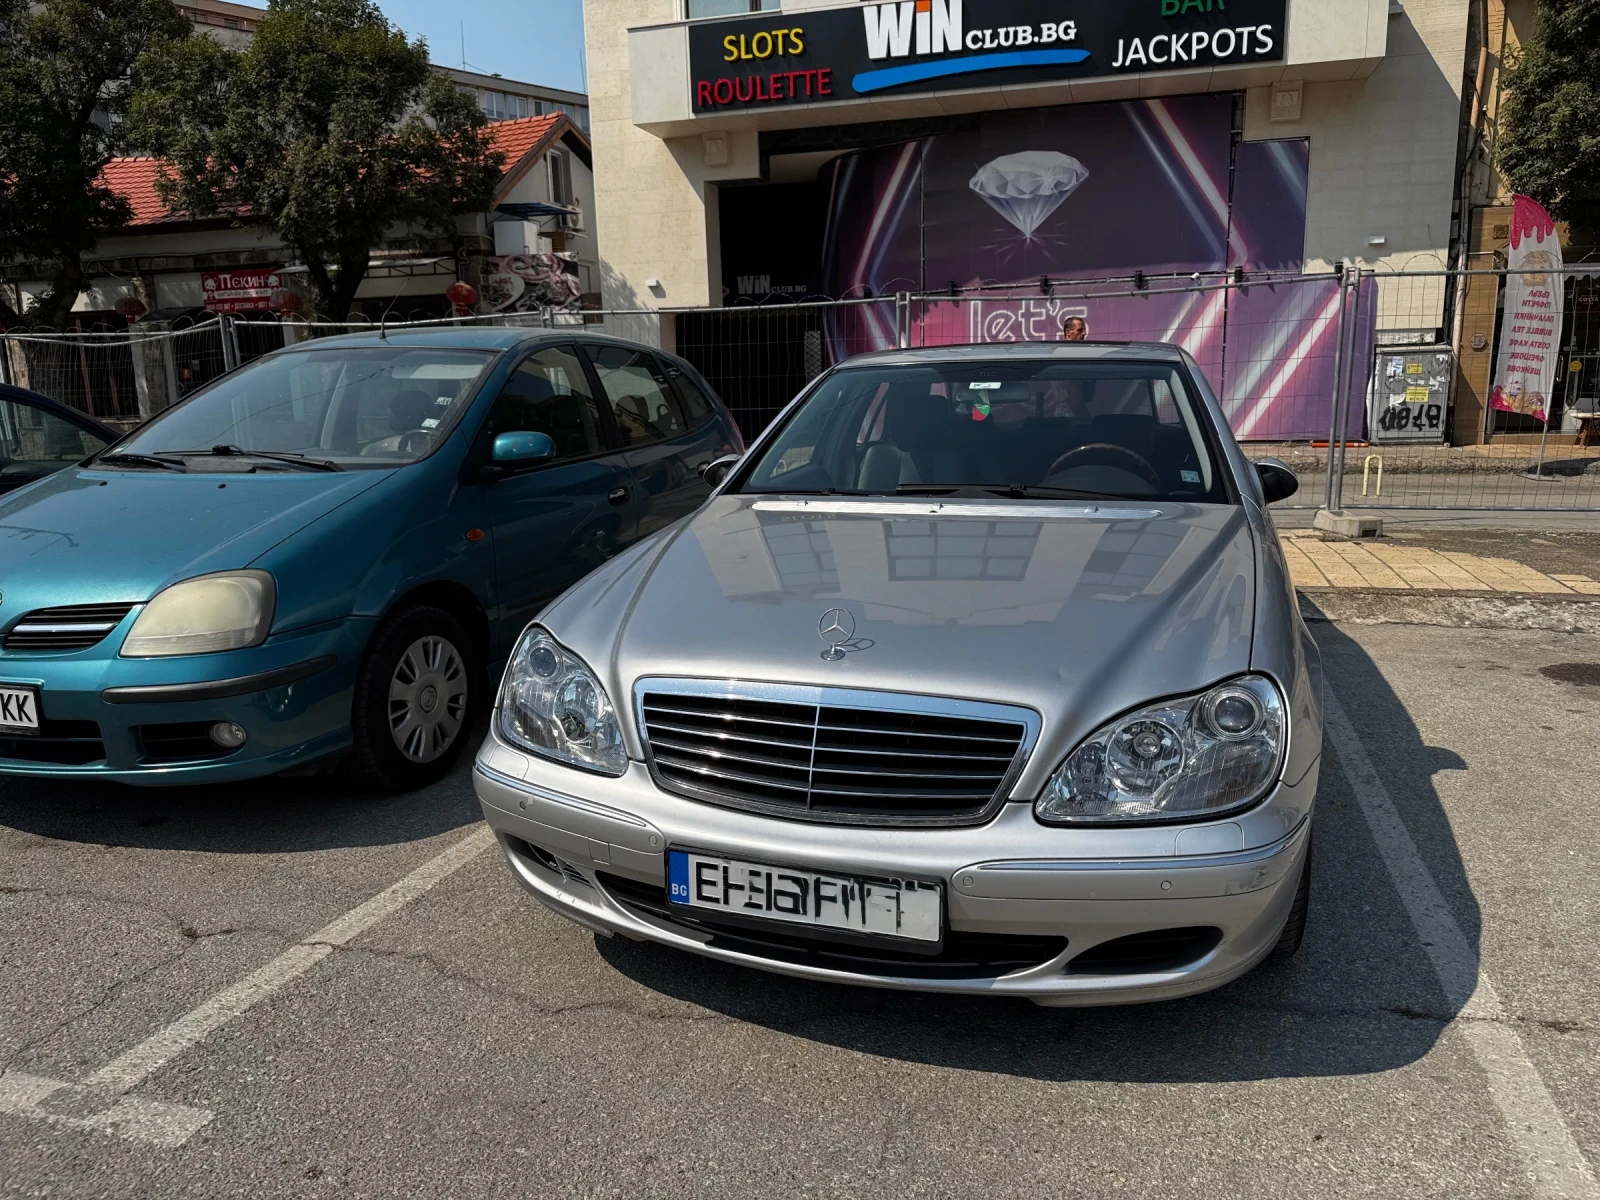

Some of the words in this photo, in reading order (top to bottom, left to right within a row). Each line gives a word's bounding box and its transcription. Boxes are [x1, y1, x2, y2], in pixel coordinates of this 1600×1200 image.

[723, 28, 804, 62] SLOTS
[1112, 24, 1274, 67] JACKPOTS
[697, 68, 833, 106] ROULETTE
[671, 883, 688, 897] BG
